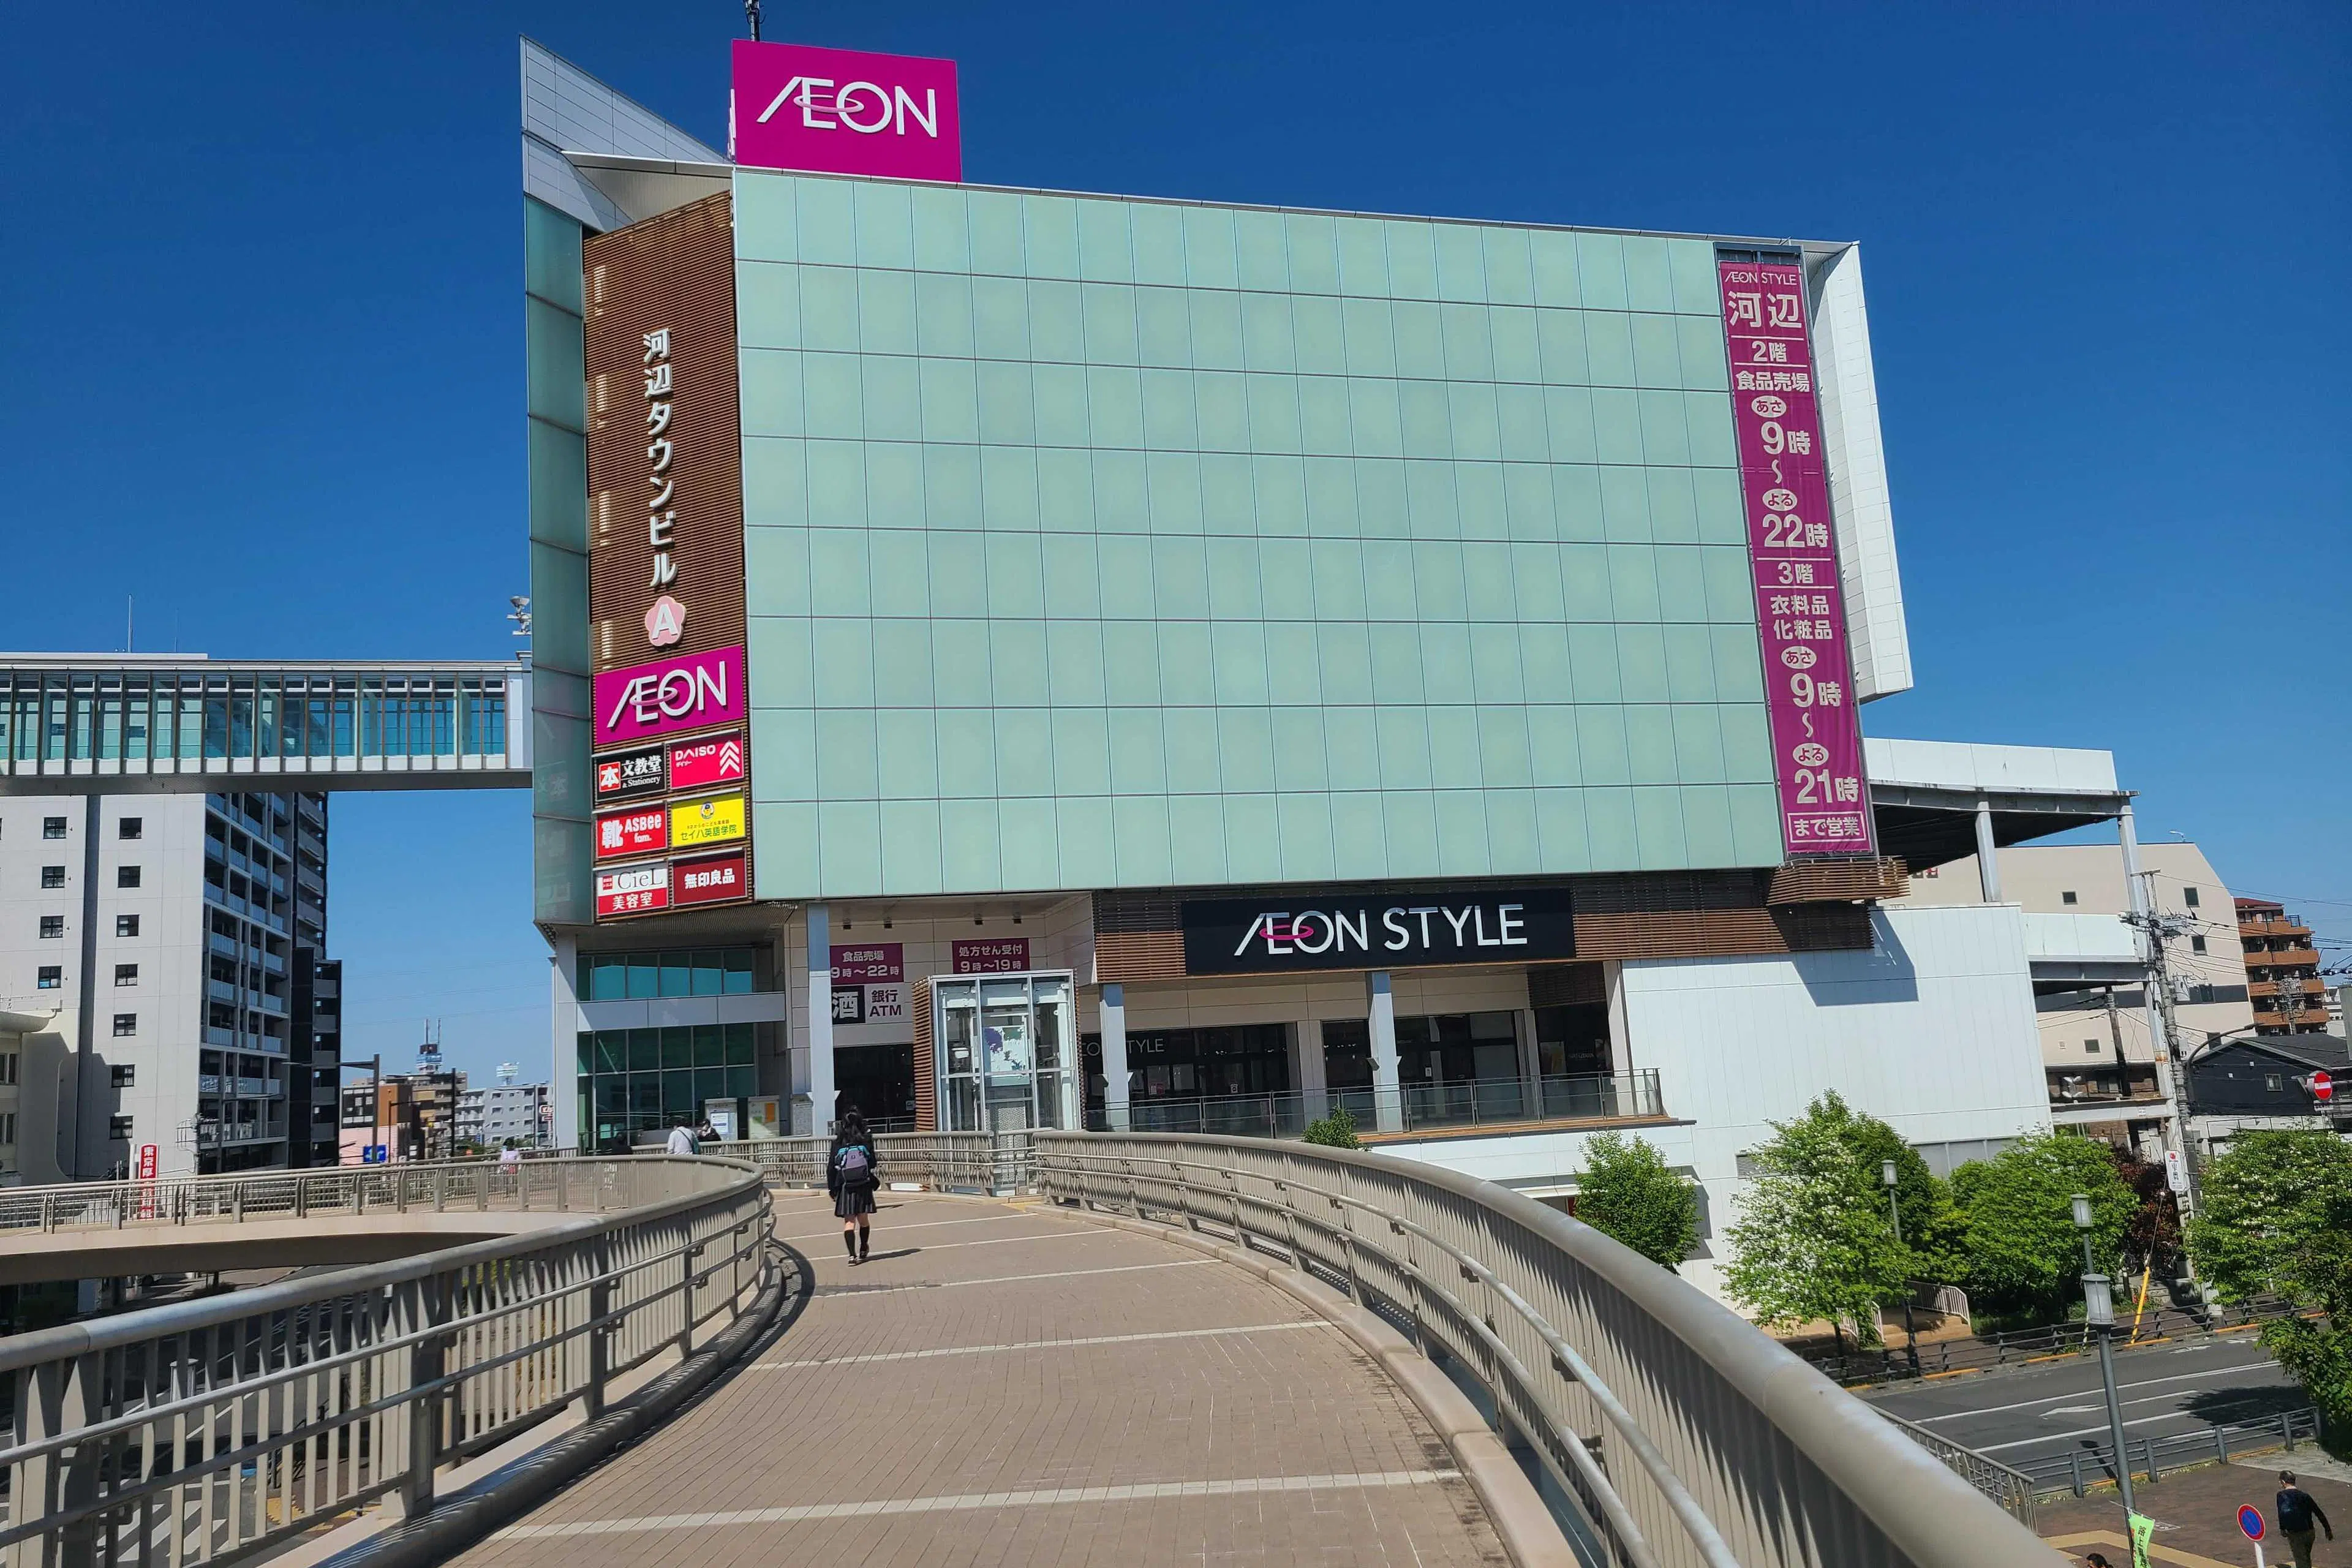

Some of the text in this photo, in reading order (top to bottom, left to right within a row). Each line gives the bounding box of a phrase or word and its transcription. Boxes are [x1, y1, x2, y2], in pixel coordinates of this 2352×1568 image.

[1762, 273, 1796, 285] STYLE
[1728, 291, 1802, 329] 河辺
[1752, 341, 1787, 363] 2階
[1736, 371, 1810, 393] 食品売場
[1756, 400, 1782, 414] あさ
[1761, 421, 1811, 455] 9時
[643, 328, 678, 587] 河辺タウンビル
[1768, 492, 1793, 507] よる
[1763, 514, 1828, 548] 22時
[1778, 562, 1814, 584] 3階
[1770, 595, 1830, 616] 衣料品
[1773, 619, 1833, 640] 化粧品
[1786, 650, 1812, 665] あさ
[1790, 673, 1842, 707] 9時
[675, 745, 716, 761] DAISO
[1798, 748, 1824, 762] よる
[601, 766, 619, 787] 本
[622, 755, 662, 777] 文教堂
[628, 776, 661, 786] Stationery
[1795, 769, 1859, 804] 21時
[624, 814, 662, 833] ASBee
[681, 824, 737, 840] セイハ英語学院
[1793, 819, 1860, 837] まで営業
[601, 820, 624, 849] 靴
[617, 868, 663, 889] CieL
[685, 868, 735, 889] 無印良品
[612, 892, 653, 911] 美容室
[1383, 904, 1528, 950] STYLE
[843, 951, 884, 962] 食品売場
[959, 944, 1022, 957] 処方せん受付
[832, 991, 858, 1019] 酒
[872, 989, 898, 1003] 銀行
[869, 1005, 902, 1017] ATM
[1127, 1038, 1164, 1054] TYLE
